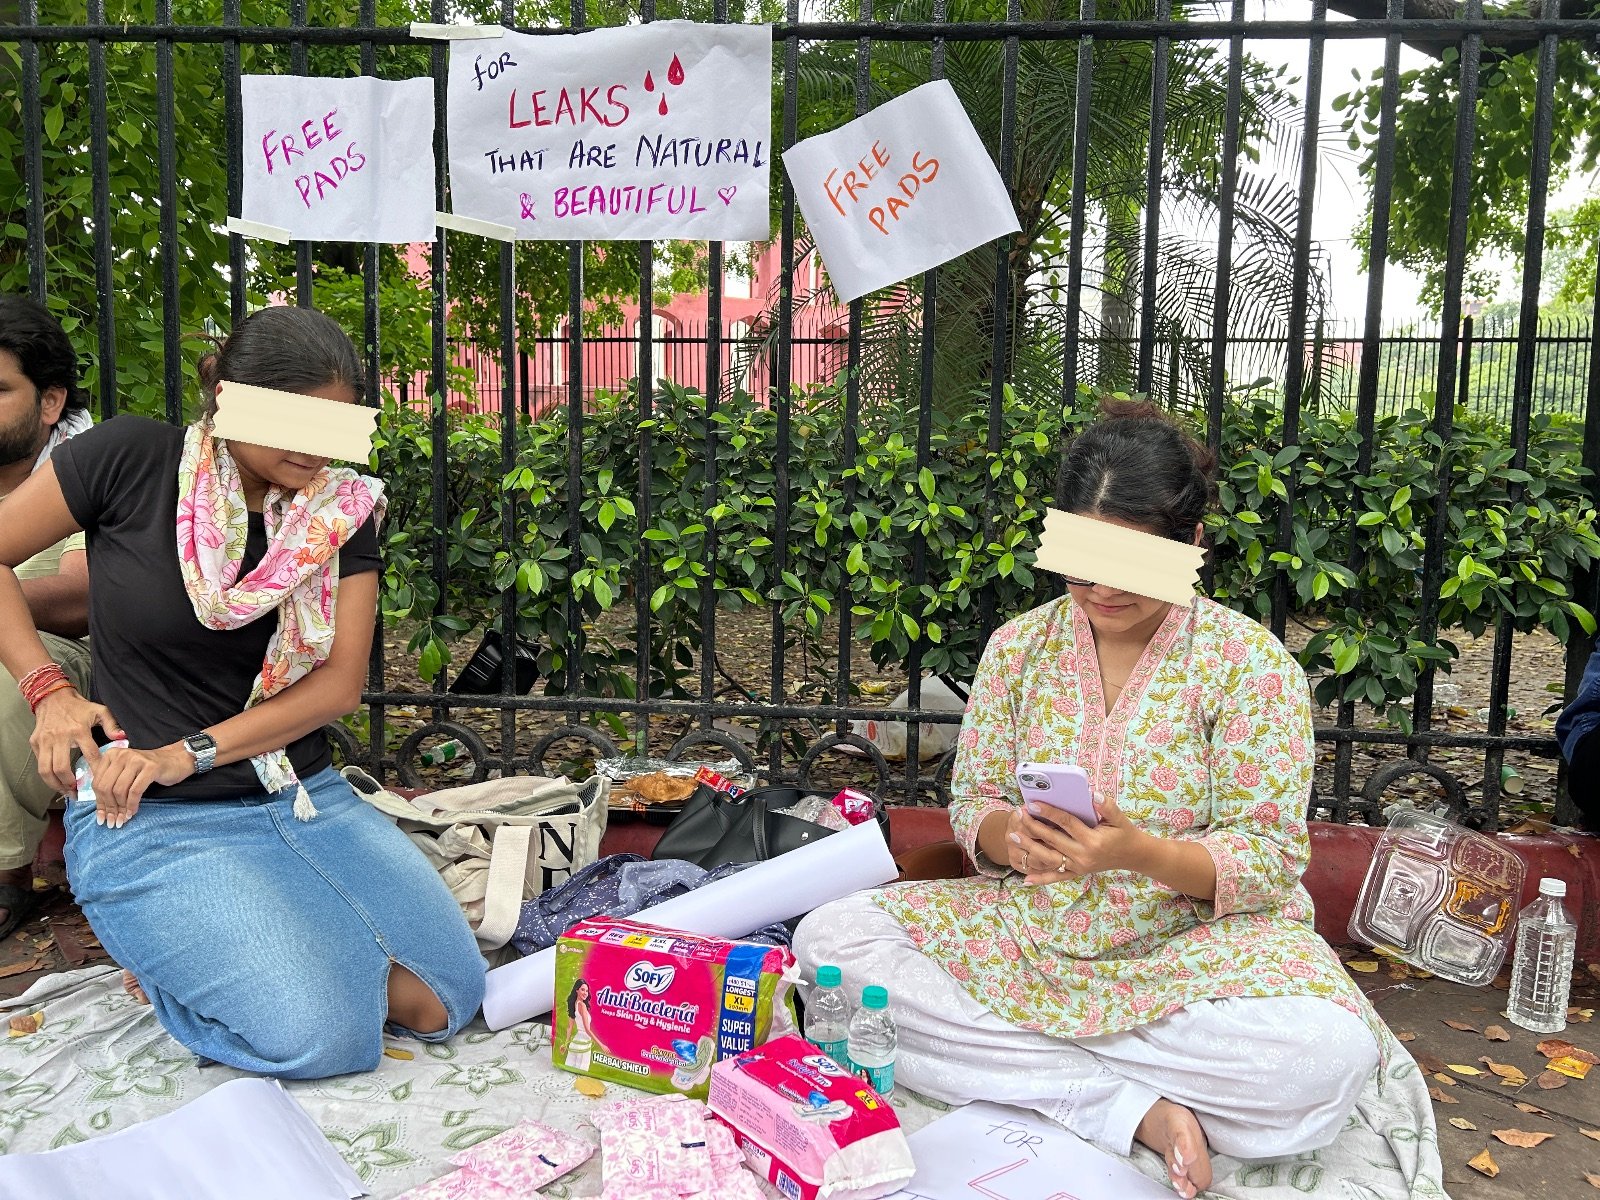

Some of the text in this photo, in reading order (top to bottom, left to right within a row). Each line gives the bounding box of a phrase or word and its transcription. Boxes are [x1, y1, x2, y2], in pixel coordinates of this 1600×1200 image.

[509, 85, 629, 129] LEAKS
[262, 108, 342, 175] FREE
[485, 134, 767, 174] THAT ARE NATURAL
[294, 141, 366, 209] PADS
[823, 140, 890, 216] FREE
[868, 150, 940, 235] PADS
[520, 183, 706, 220] & BEAUTIFUL
[632, 967, 666, 988] SOFY
[726, 986, 755, 997] LONGEST
[733, 996, 745, 1006] XL
[616, 1009, 634, 1021] Skin
[634, 1012, 649, 1026] Dry
[649, 1016, 656, 1025] &
[656, 1018, 691, 1034] Hygienic
[721, 1018, 751, 1035] SUPER
[721, 1035, 751, 1051] VALUE
[593, 1053, 649, 1075] HERBAL SHIELD
[985, 1120, 1043, 1157] FOR
